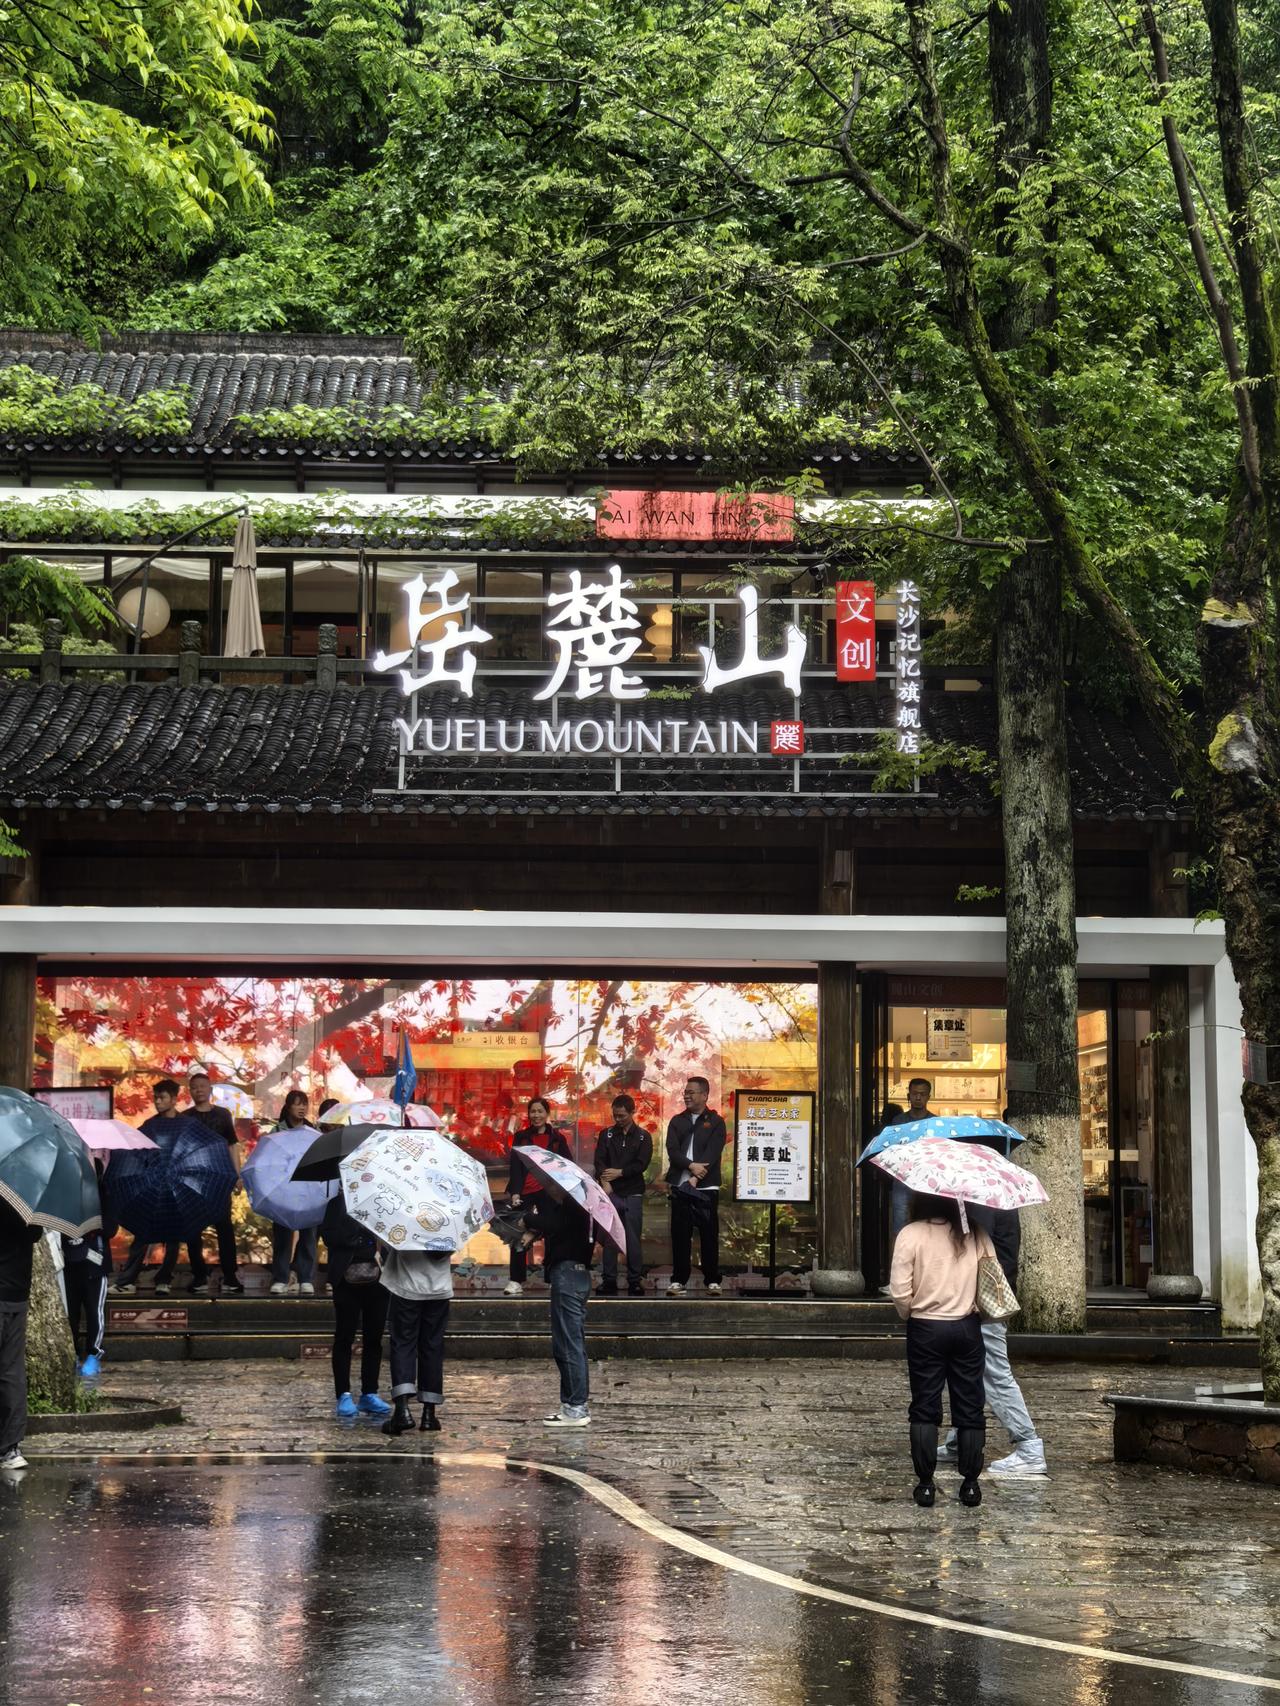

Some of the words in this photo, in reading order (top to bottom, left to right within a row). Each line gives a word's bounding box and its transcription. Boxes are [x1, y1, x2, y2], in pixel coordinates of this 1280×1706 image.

[646, 511, 695, 525] WAN
[373, 564, 808, 700] 岳麓山
[840, 593, 872, 670] 文创
[896, 579, 922, 754] 长沙记忆旗舰店
[396, 718, 524, 753] YUELU
[540, 719, 758, 754] MOUNTAIN
[495, 1034, 529, 1046] 收银台
[747, 1146, 791, 1162] 集章处
